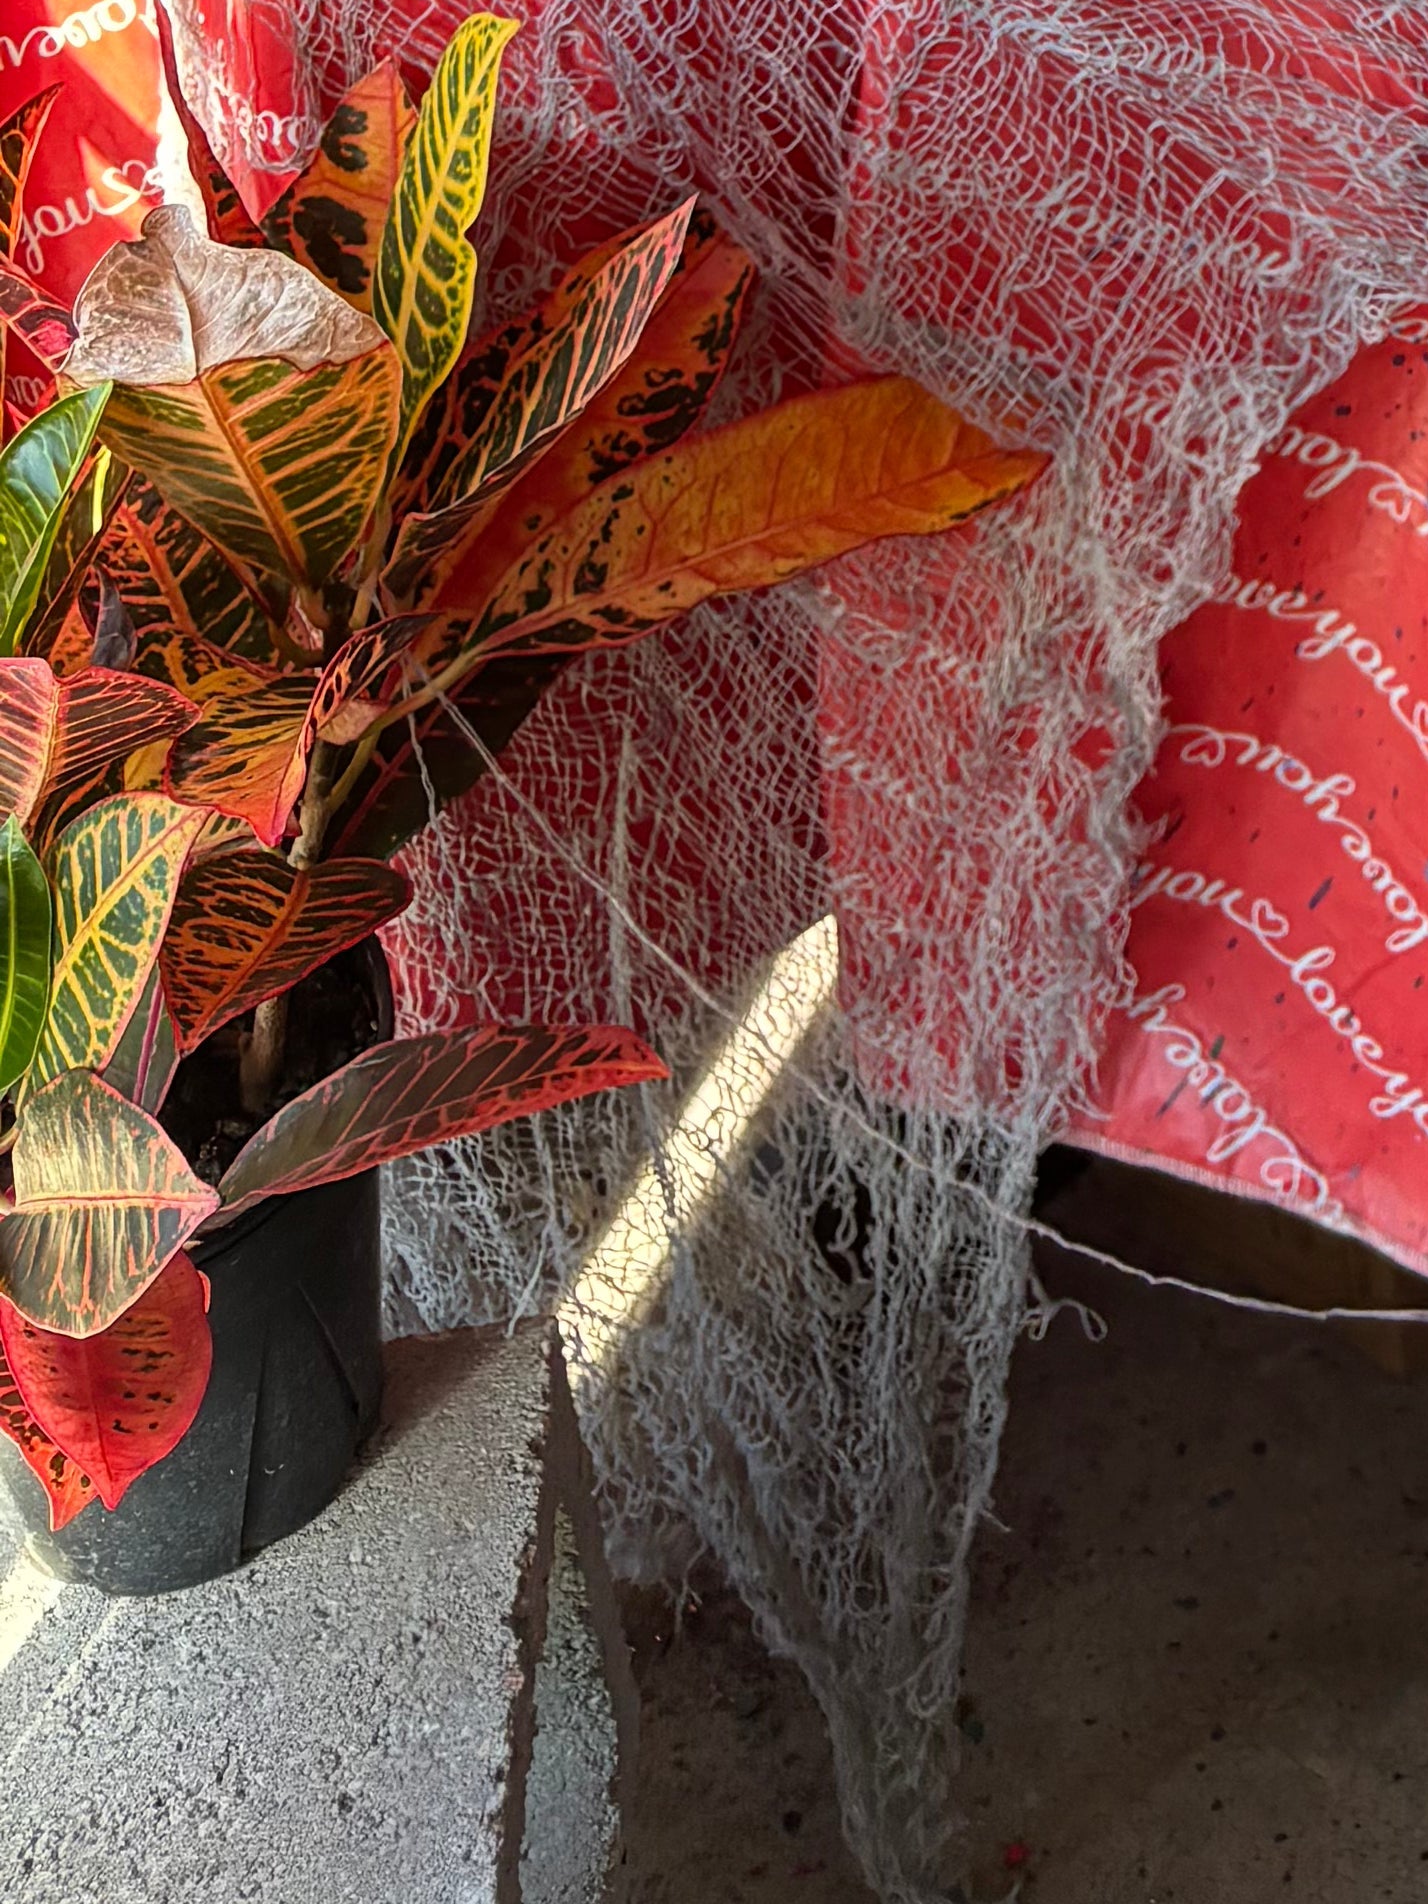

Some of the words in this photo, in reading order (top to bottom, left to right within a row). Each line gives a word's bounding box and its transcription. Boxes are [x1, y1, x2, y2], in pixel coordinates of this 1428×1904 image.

[1297, 610, 1410, 704] you
[1236, 736, 1357, 821] you
[1289, 945, 1385, 1065] love
[1164, 1038, 1267, 1163] love
